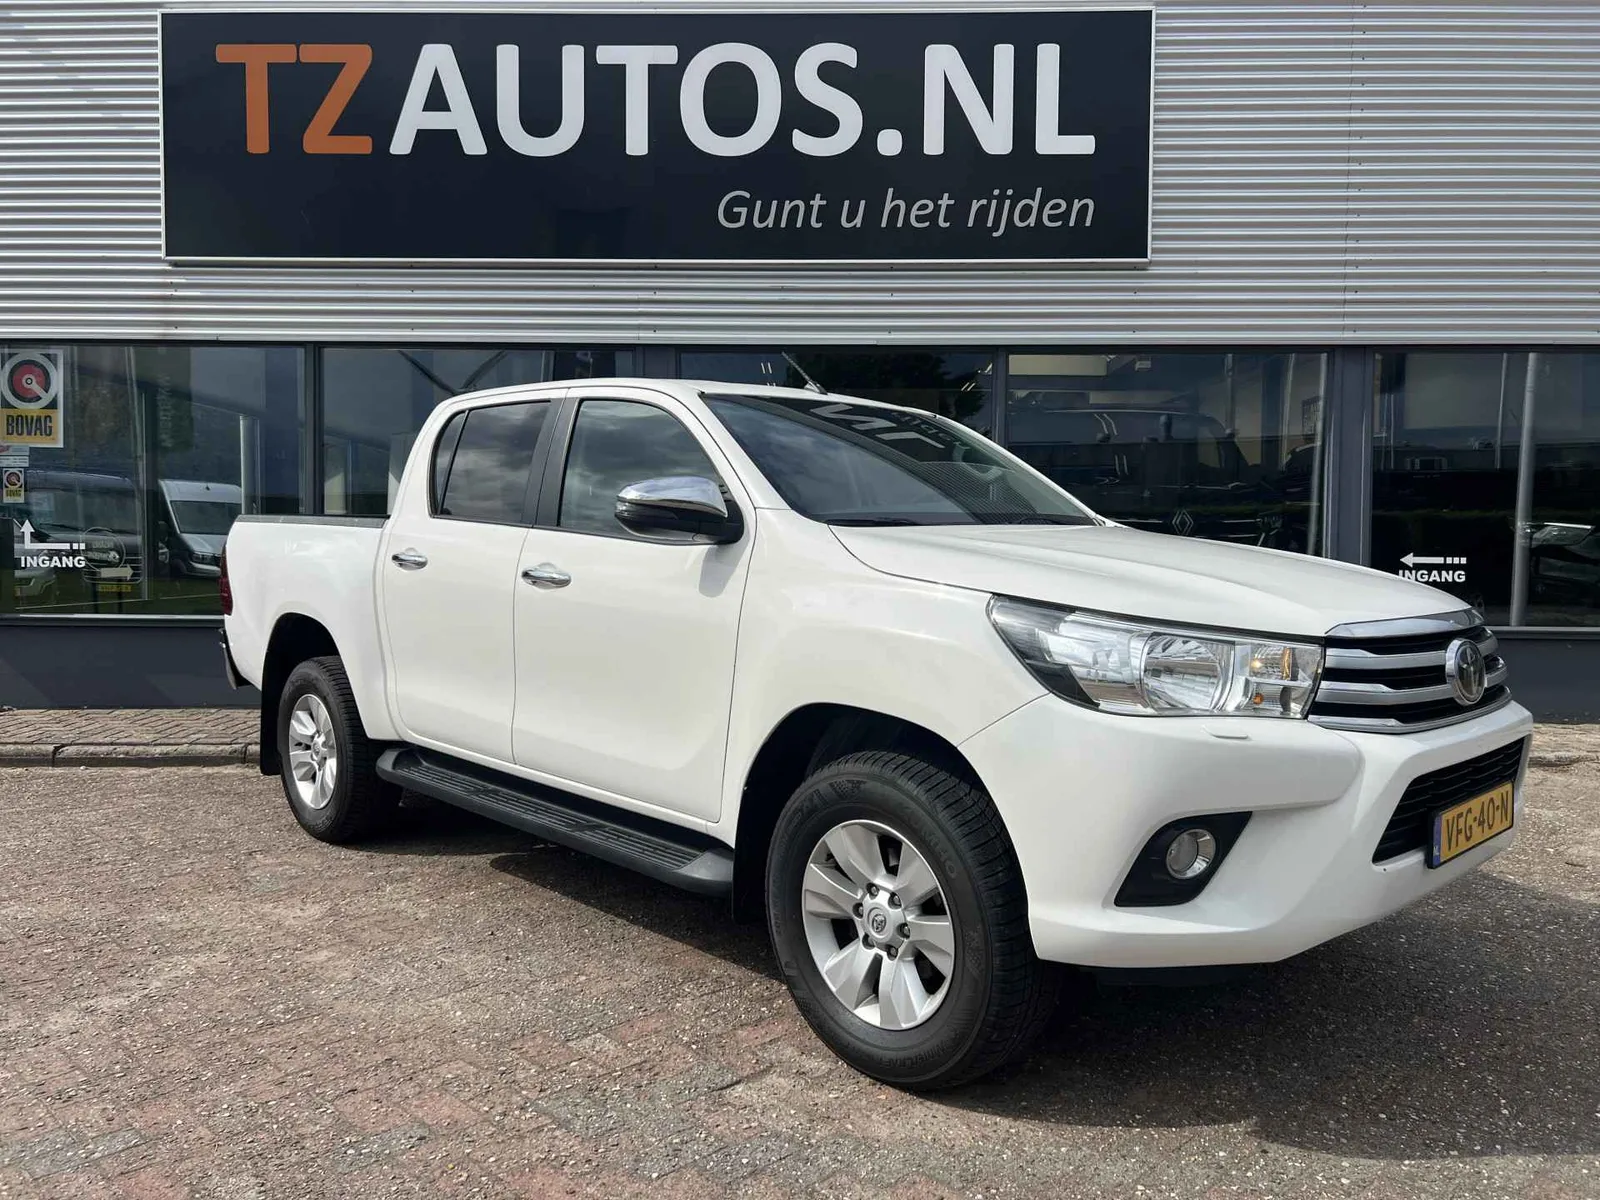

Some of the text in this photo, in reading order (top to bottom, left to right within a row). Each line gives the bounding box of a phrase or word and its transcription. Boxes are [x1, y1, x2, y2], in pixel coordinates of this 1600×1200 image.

[215, 42, 1096, 158] TZAUTOS.NL
[717, 186, 1095, 238] Gunt u het rijden
[6, 414, 53, 436] BOVAG
[20, 555, 86, 568] INGANG
[1399, 569, 1466, 582] INGANG
[1446, 790, 1509, 852] VFG-40-N
